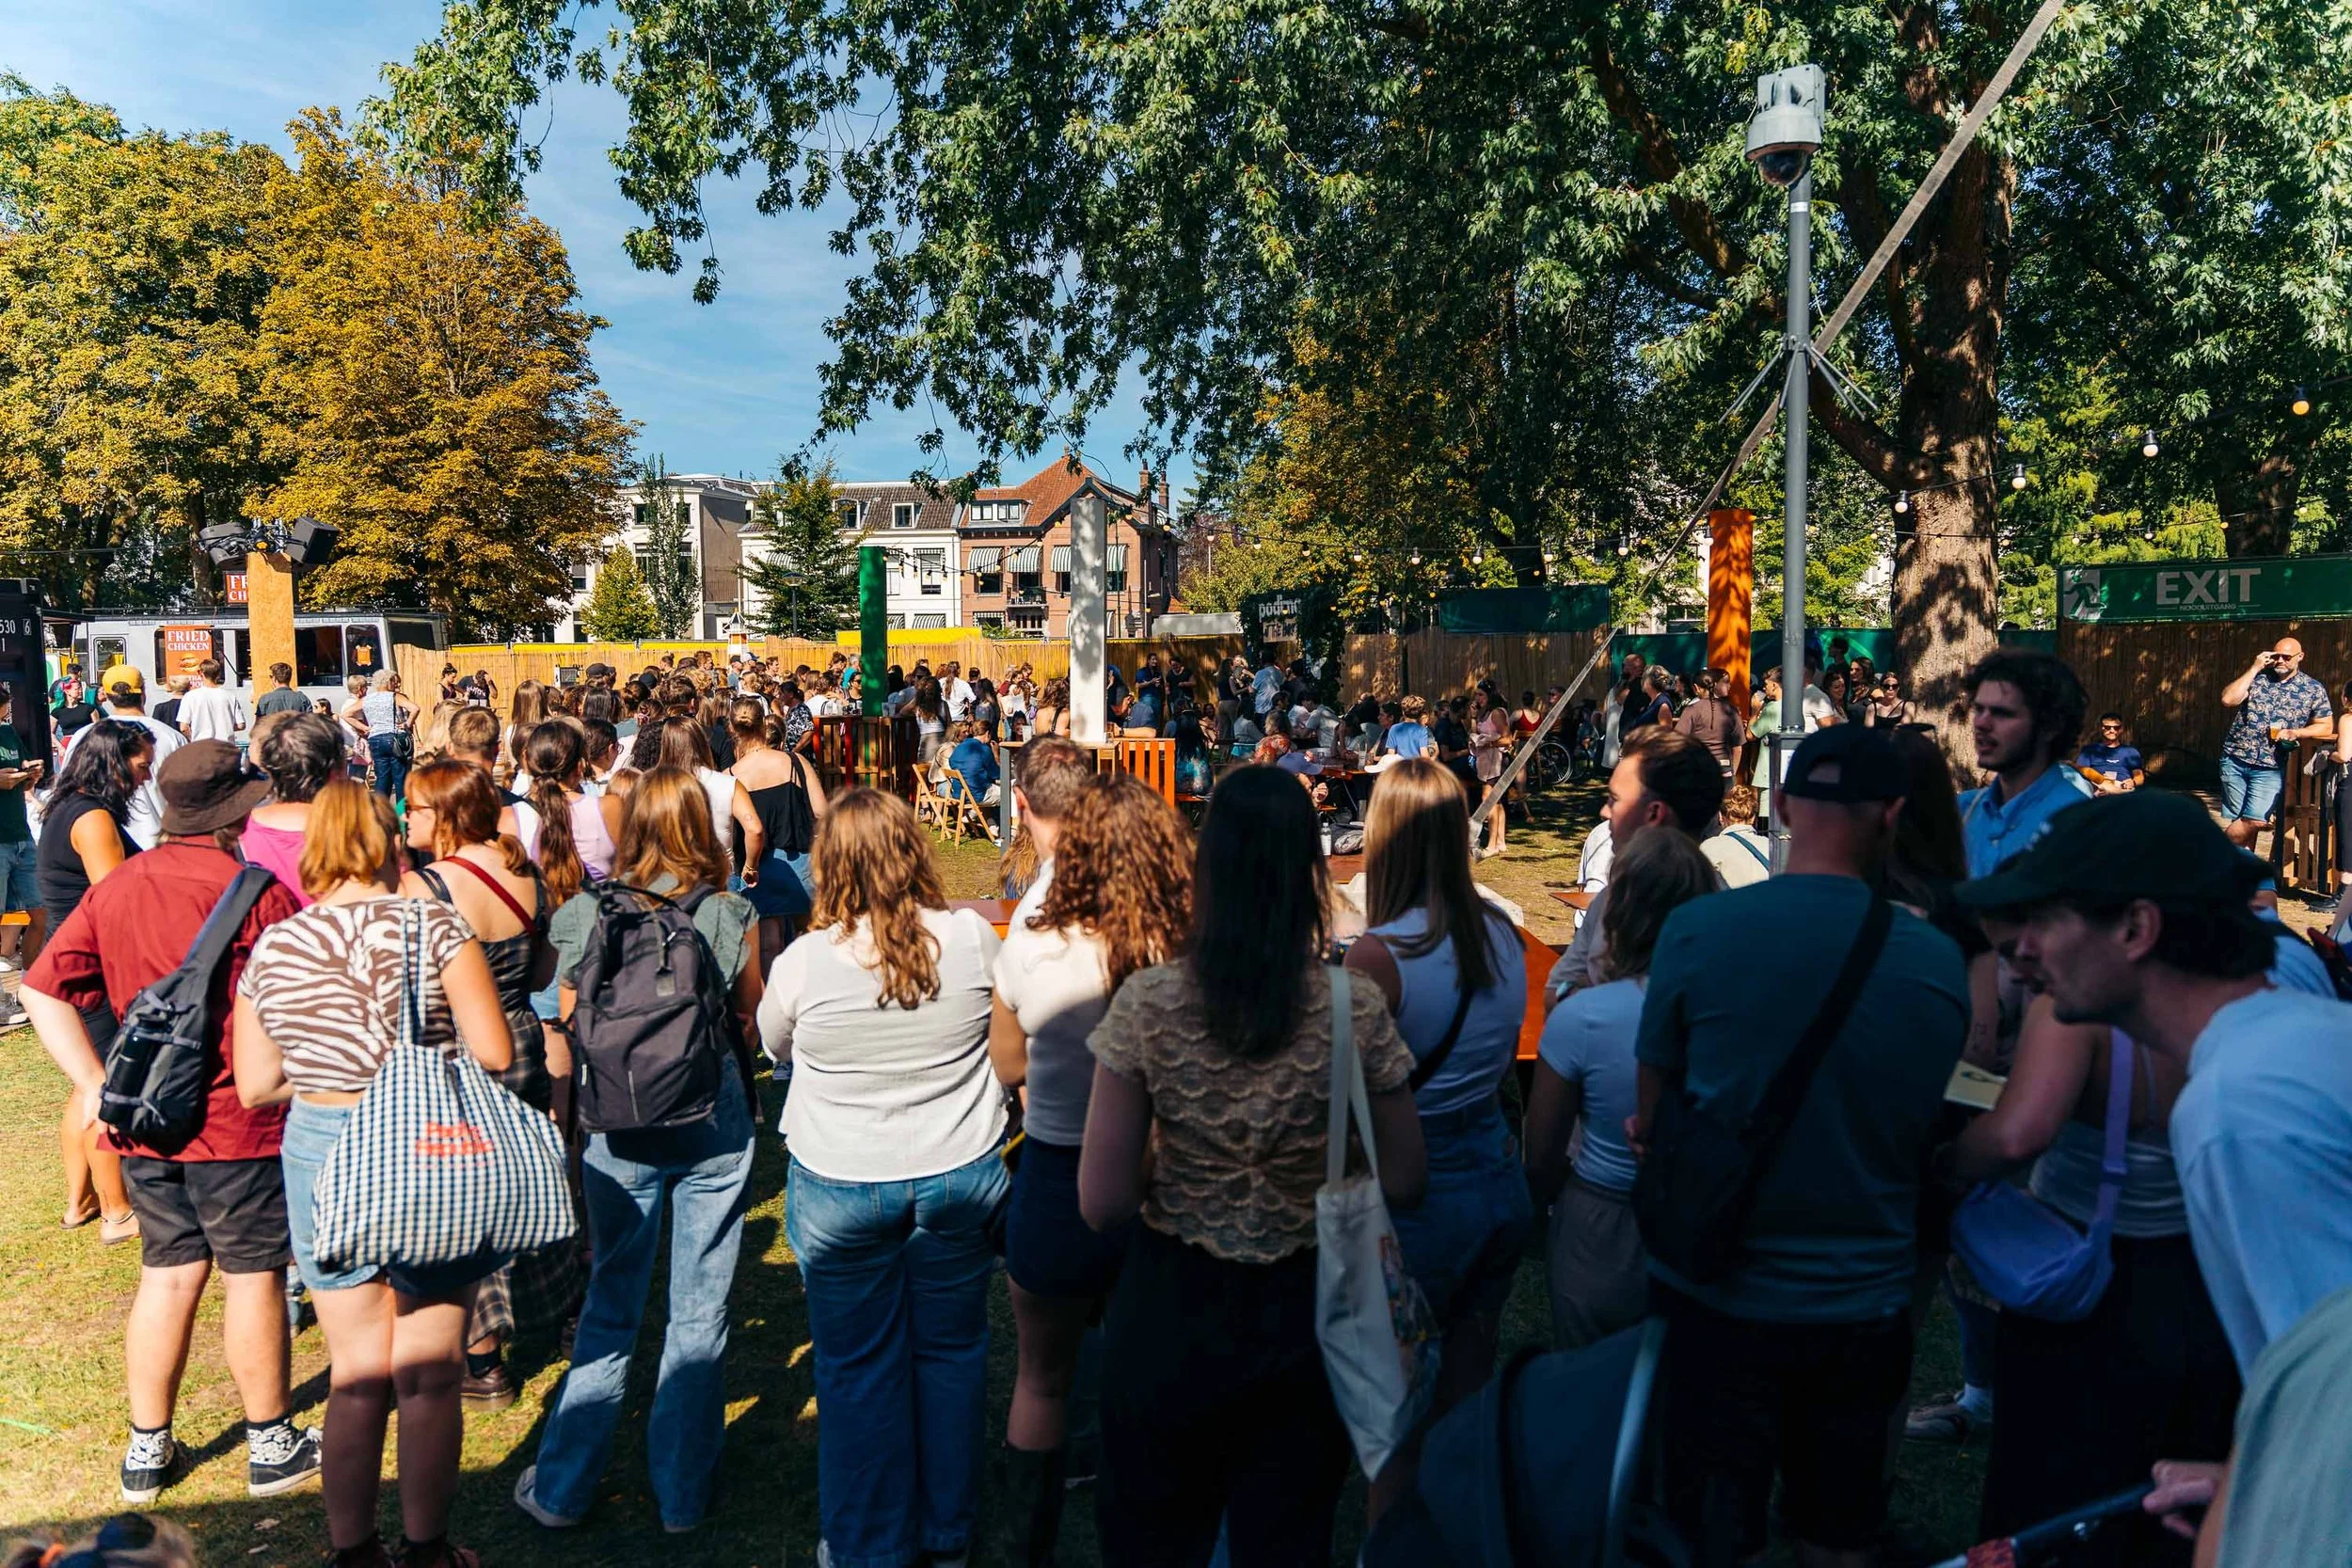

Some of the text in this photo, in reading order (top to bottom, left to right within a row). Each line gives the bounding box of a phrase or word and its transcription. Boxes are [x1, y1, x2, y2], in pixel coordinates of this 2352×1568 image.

[2155, 568, 2262, 605] EXIT
[167, 630, 209, 641] FRIED
[167, 642, 209, 651] CHICKEN
